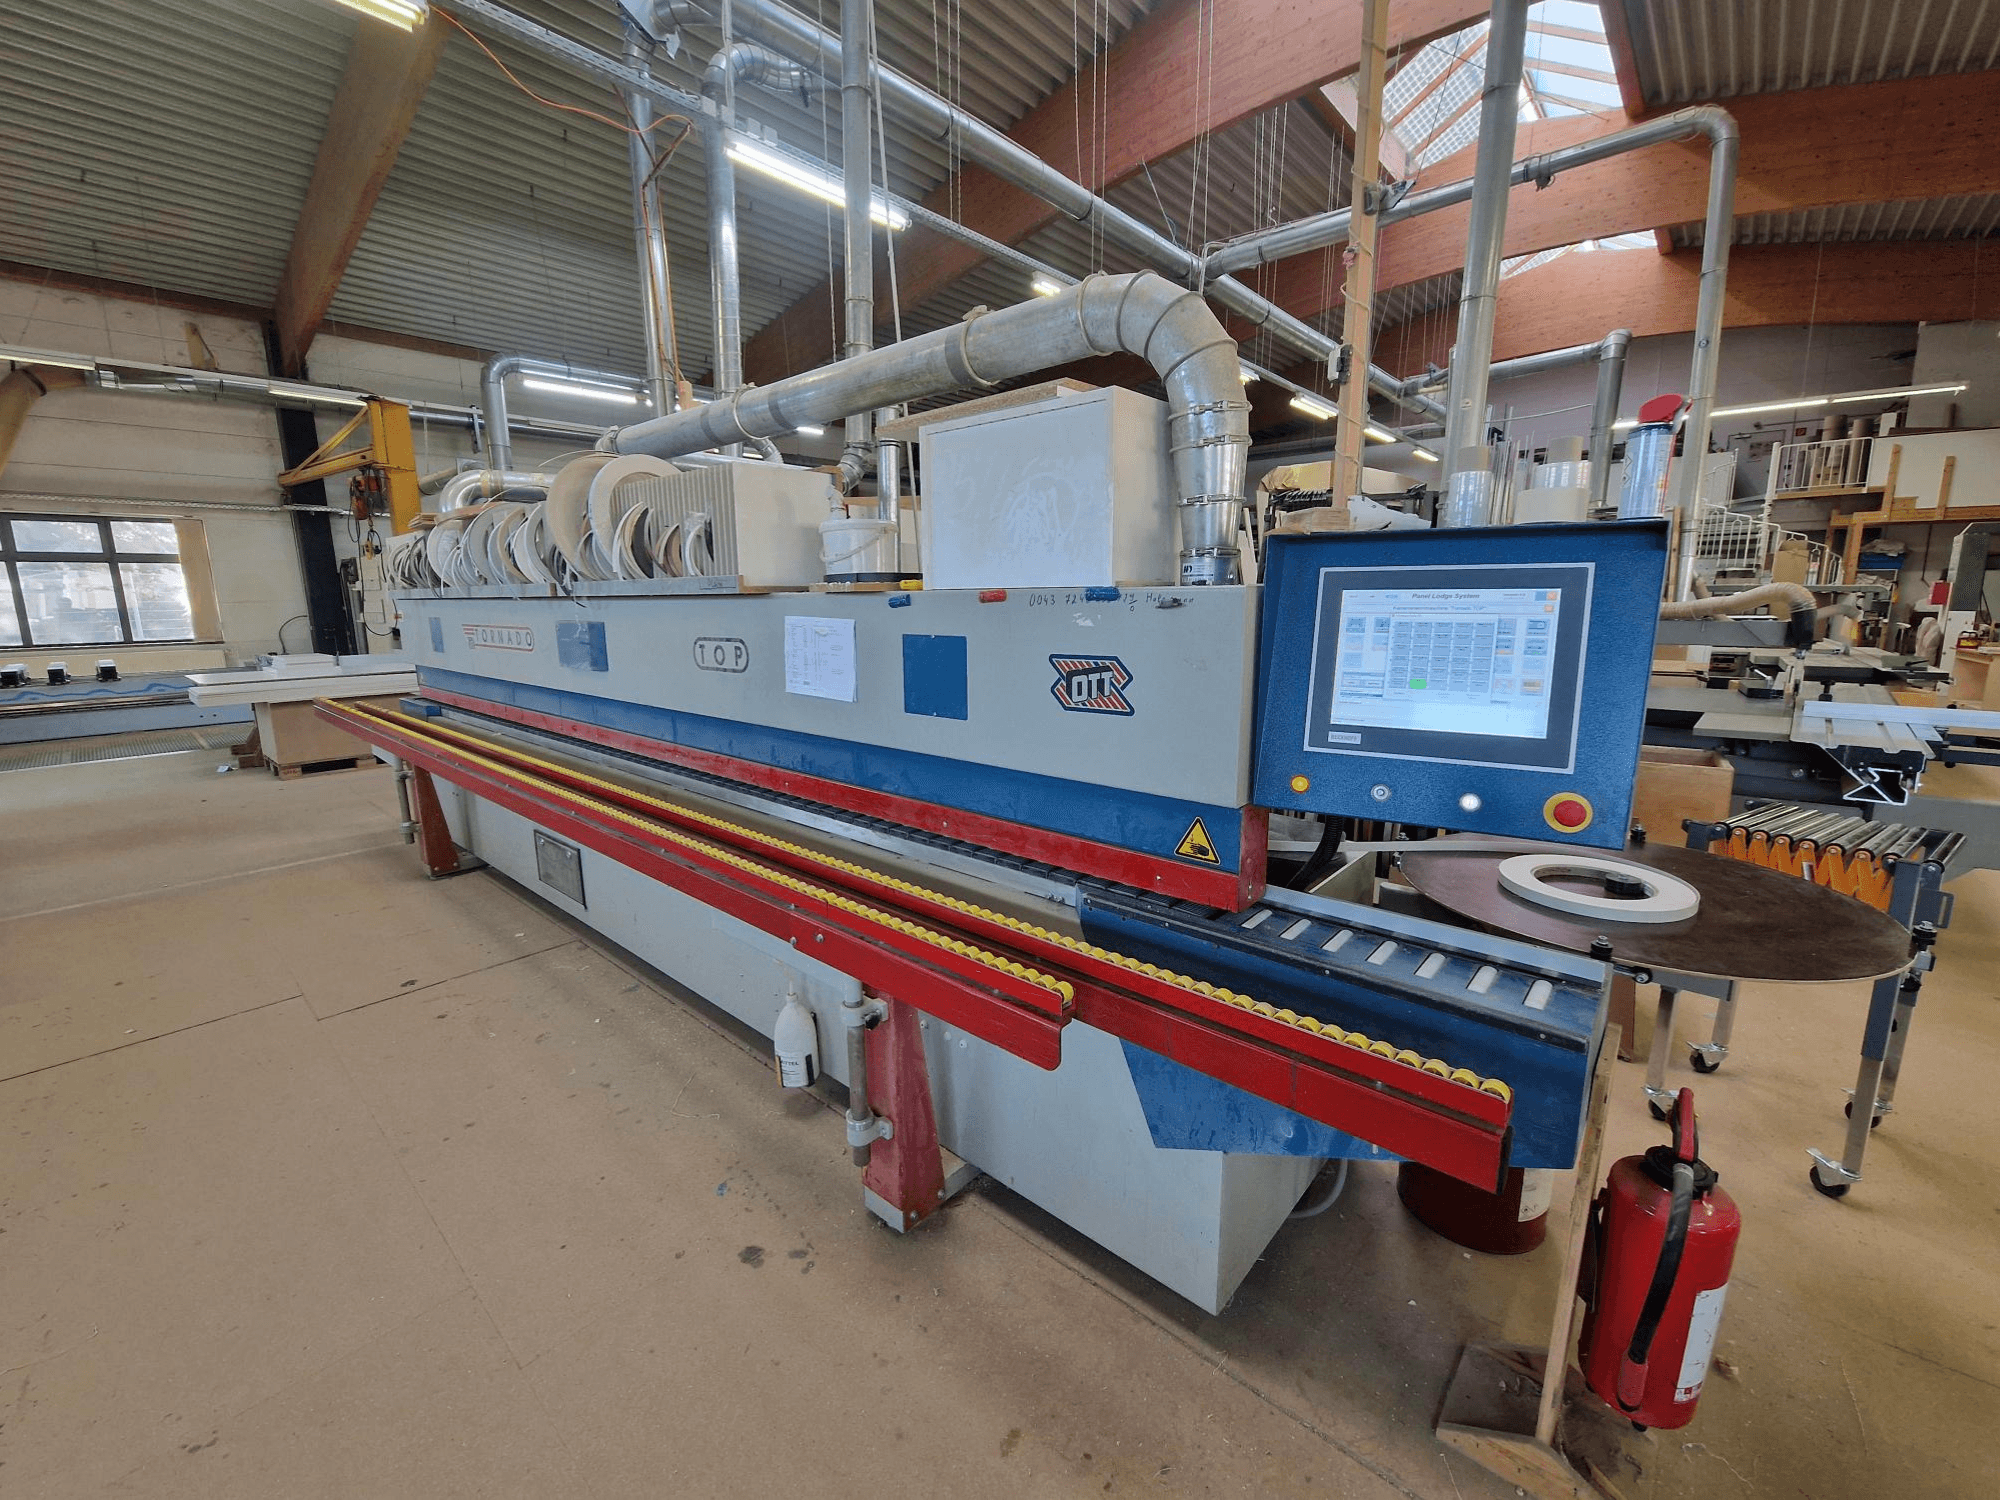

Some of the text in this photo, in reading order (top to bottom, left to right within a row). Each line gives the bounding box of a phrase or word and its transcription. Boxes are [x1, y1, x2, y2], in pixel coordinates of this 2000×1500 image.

[1029, 593, 1056, 607] 0043
[474, 628, 532, 646] TORNADO
[698, 640, 743, 667] TOP
[1067, 666, 1115, 703] OTT
